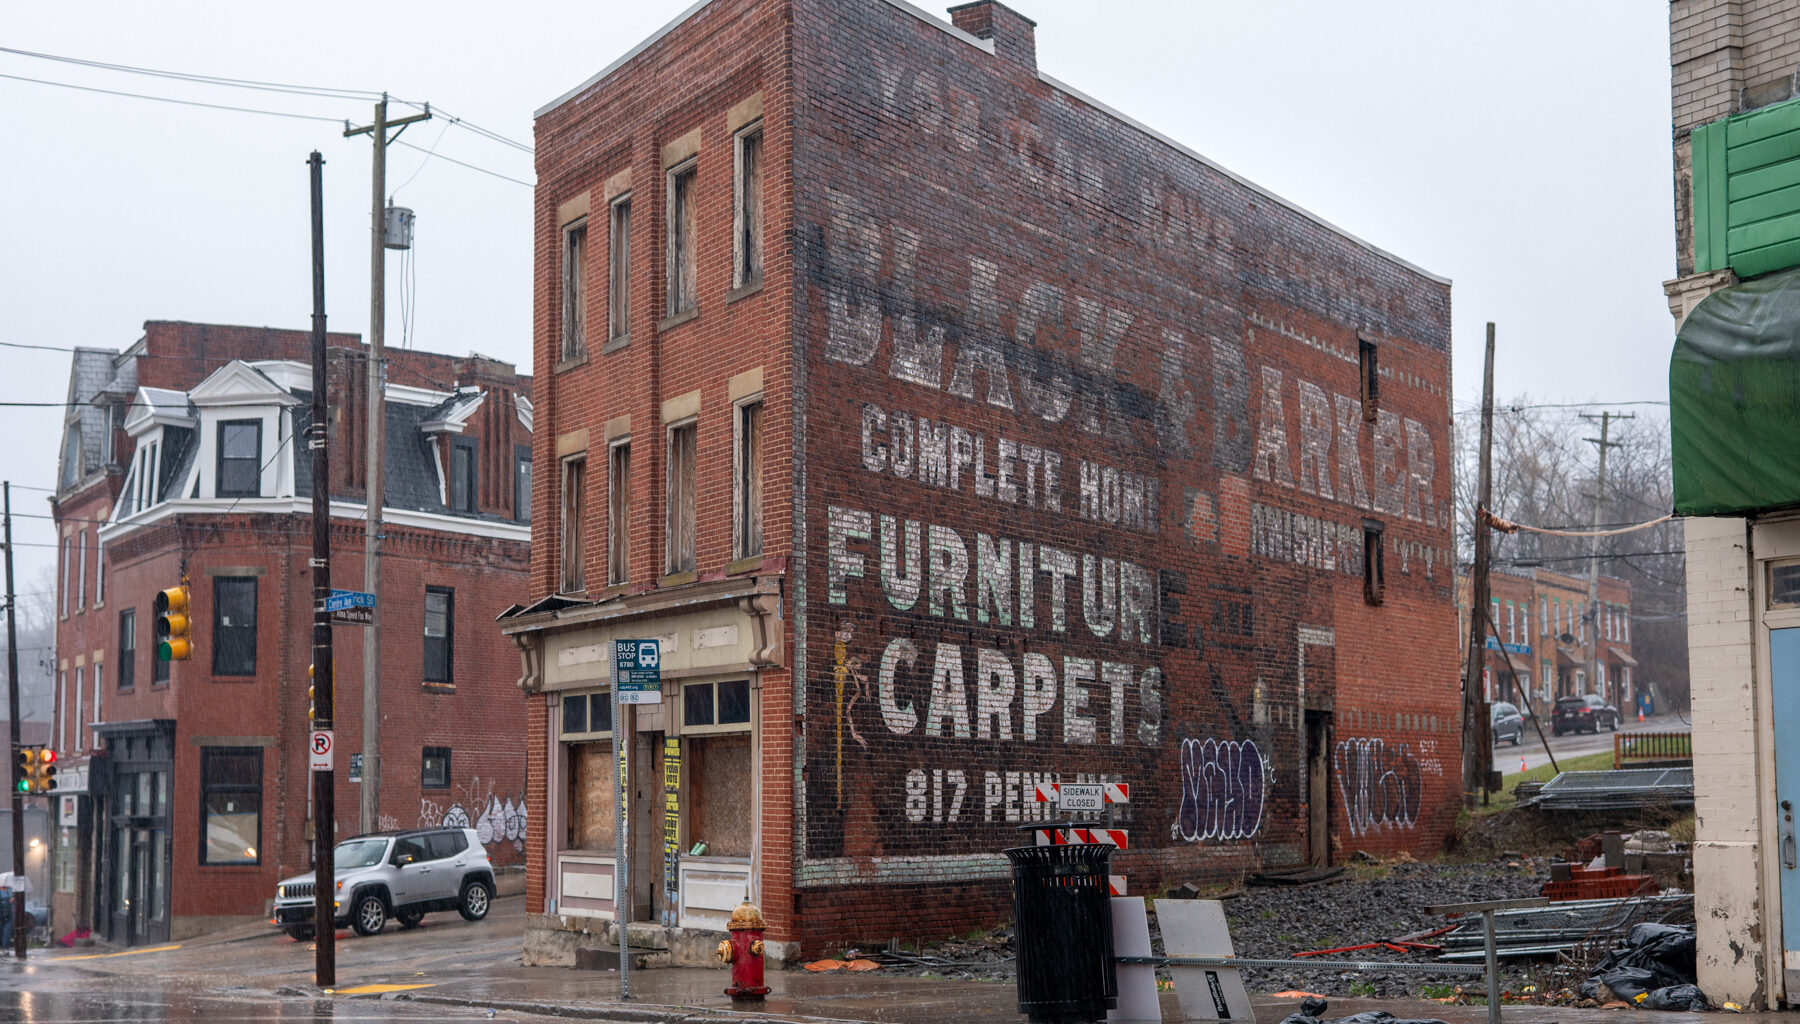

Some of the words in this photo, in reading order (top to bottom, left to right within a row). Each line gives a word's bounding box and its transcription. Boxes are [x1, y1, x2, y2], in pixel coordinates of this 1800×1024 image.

[862, 403, 1062, 513] COMPLETE
[617, 643, 636, 652] BUS
[879, 637, 1167, 747] CARPETS
[666, 764, 679, 774] YOUR
[666, 774, 678, 784] VOTE
[905, 768, 968, 823] 817
[1063, 788, 1100, 796] SIDEWALK
[1067, 799, 1096, 807] CLOSED
